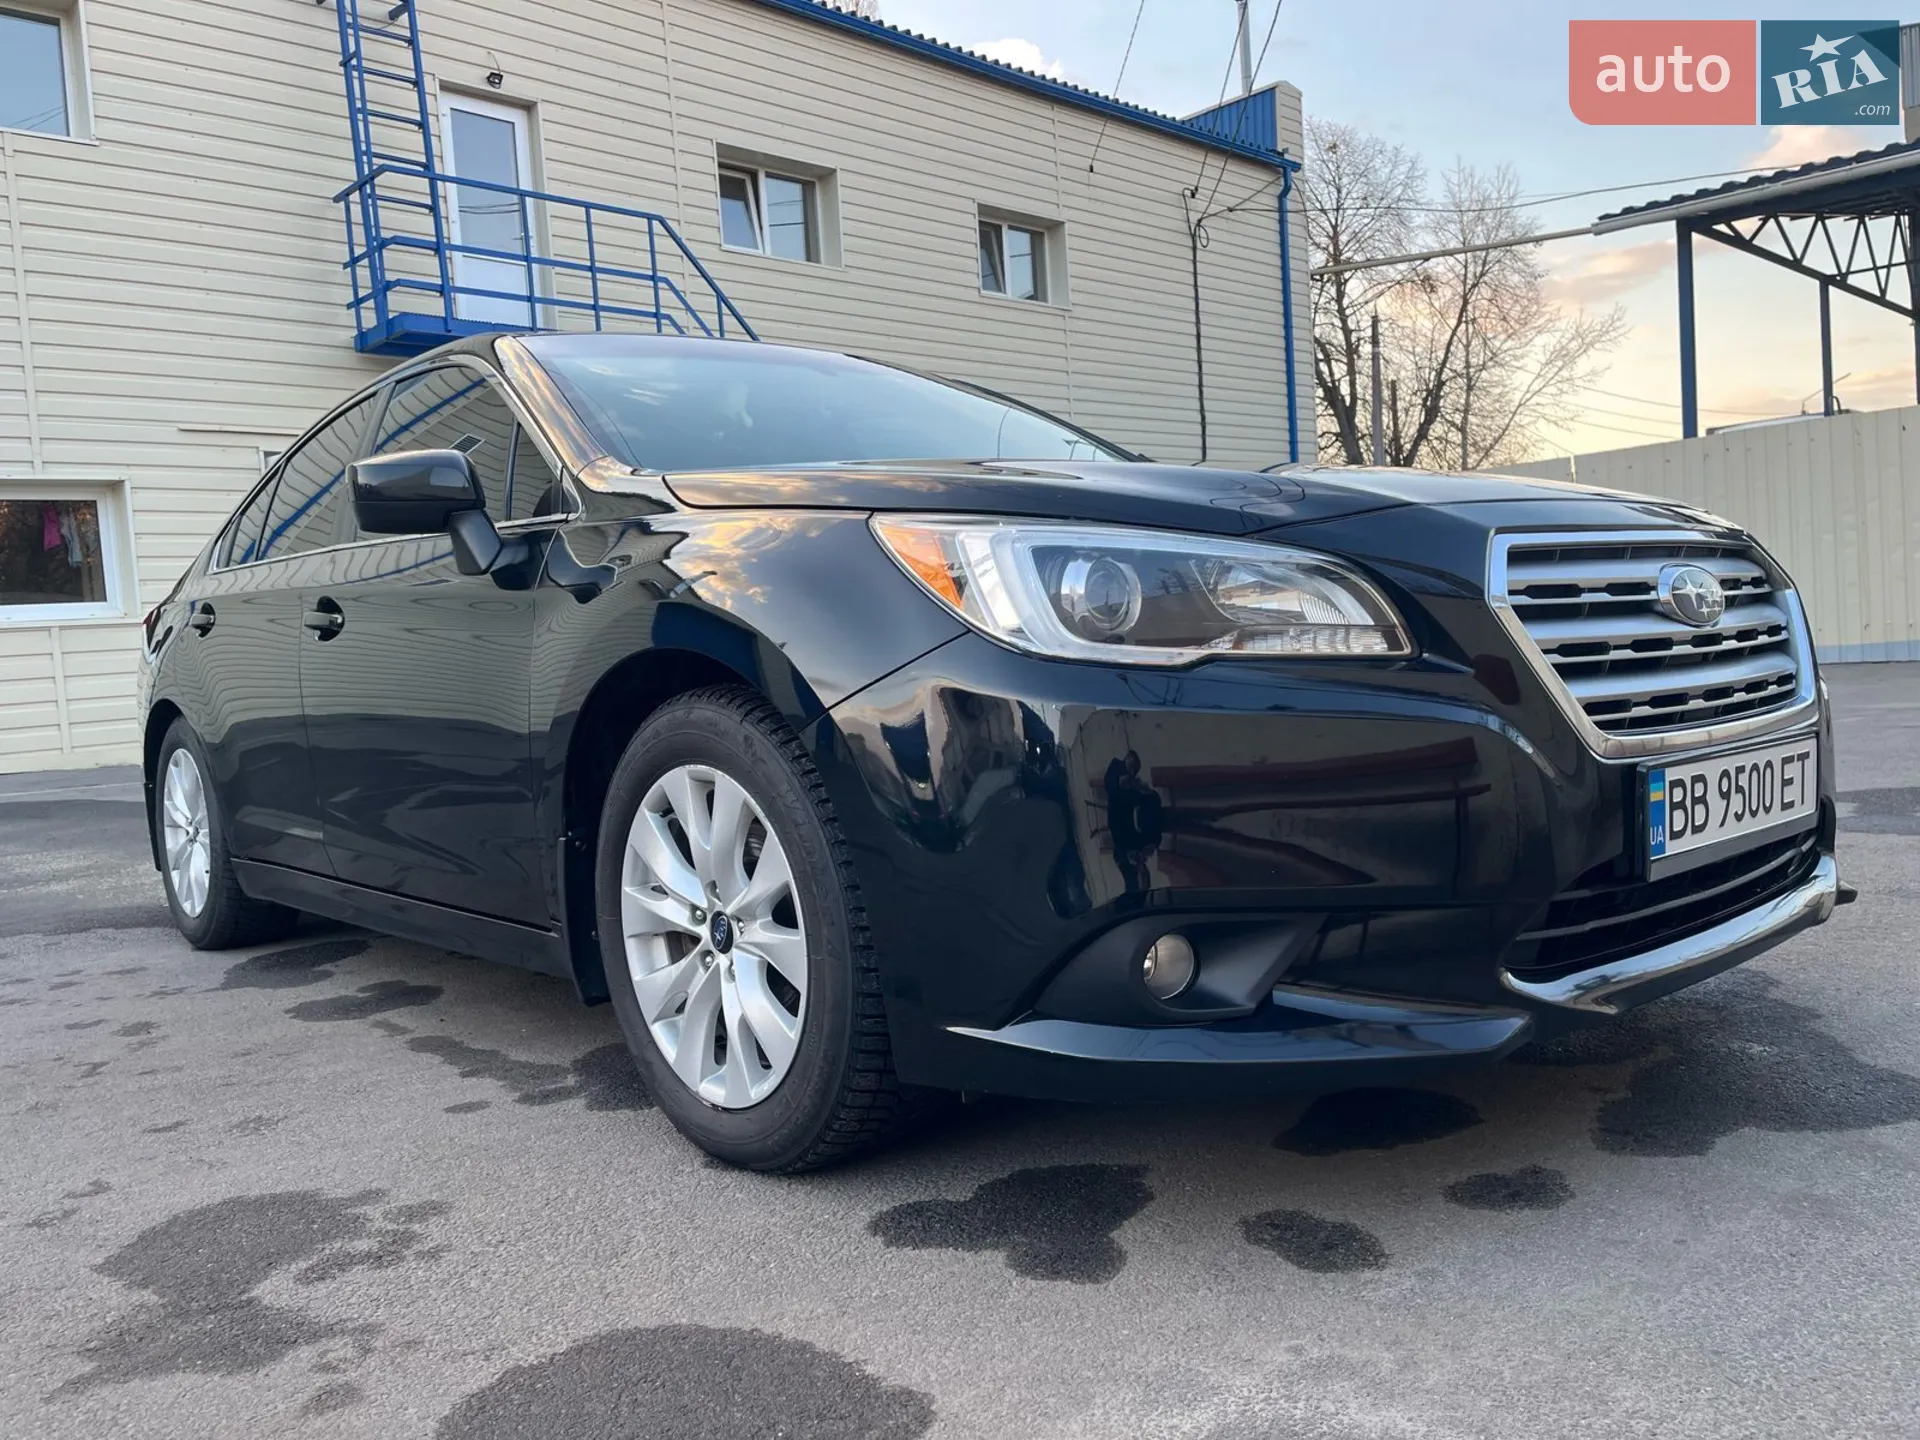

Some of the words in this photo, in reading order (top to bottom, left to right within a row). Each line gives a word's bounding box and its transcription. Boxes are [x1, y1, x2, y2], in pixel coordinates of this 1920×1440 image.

[1668, 773, 1710, 841] BB
[1717, 759, 1775, 828] 9500
[1780, 750, 1811, 811] ET
[1650, 825, 1664, 846] UA
